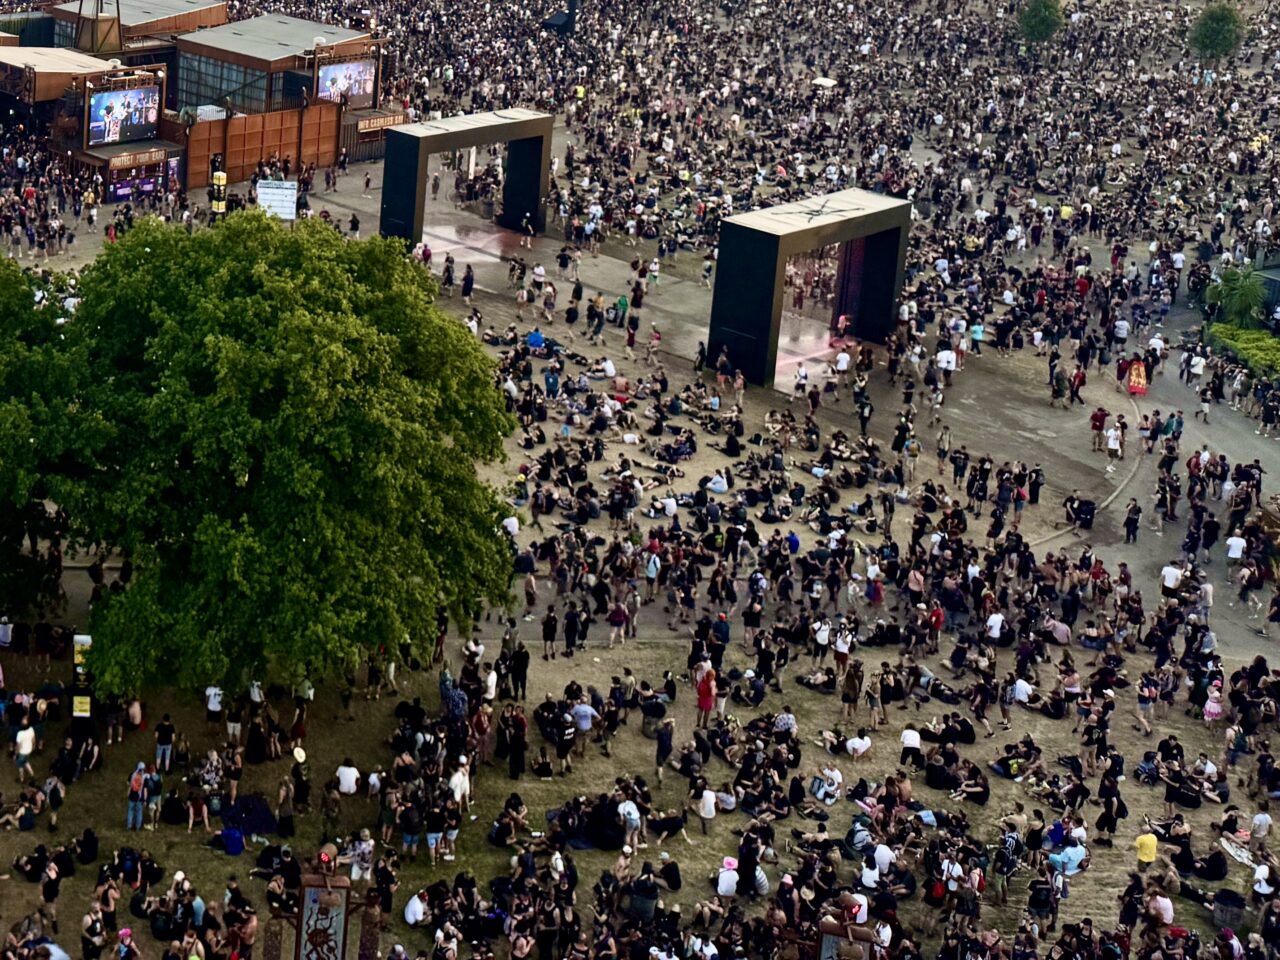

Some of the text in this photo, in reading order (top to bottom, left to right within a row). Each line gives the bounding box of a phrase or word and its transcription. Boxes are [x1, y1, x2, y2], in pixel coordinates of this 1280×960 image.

[111, 150, 165, 167] PROTECT YOUR EARS
